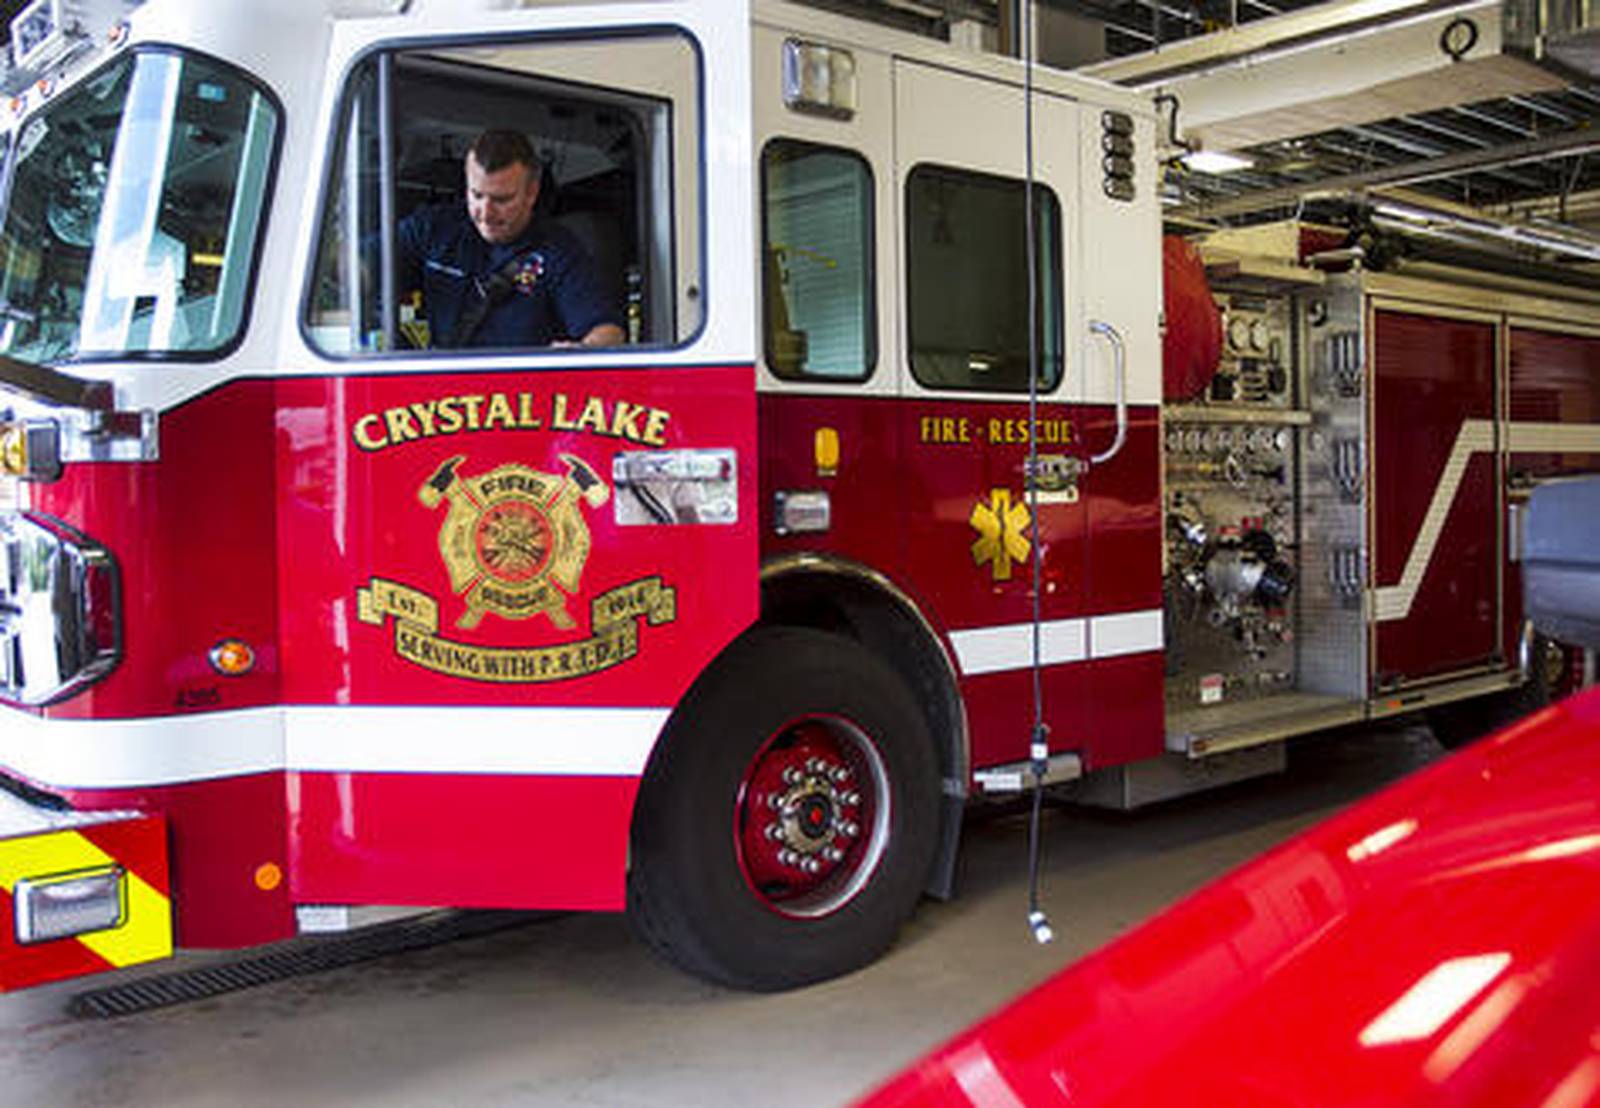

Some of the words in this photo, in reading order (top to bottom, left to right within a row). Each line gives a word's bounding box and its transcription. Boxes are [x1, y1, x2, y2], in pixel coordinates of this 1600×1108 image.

[352, 393, 542, 450] CRYSTAL
[550, 394, 671, 446] LAKE
[920, 416, 971, 442] FIRE
[988, 418, 1072, 443] RESCUE
[480, 474, 547, 497] FIRE
[400, 631, 481, 674] SERVING
[483, 655, 536, 675] WITH
